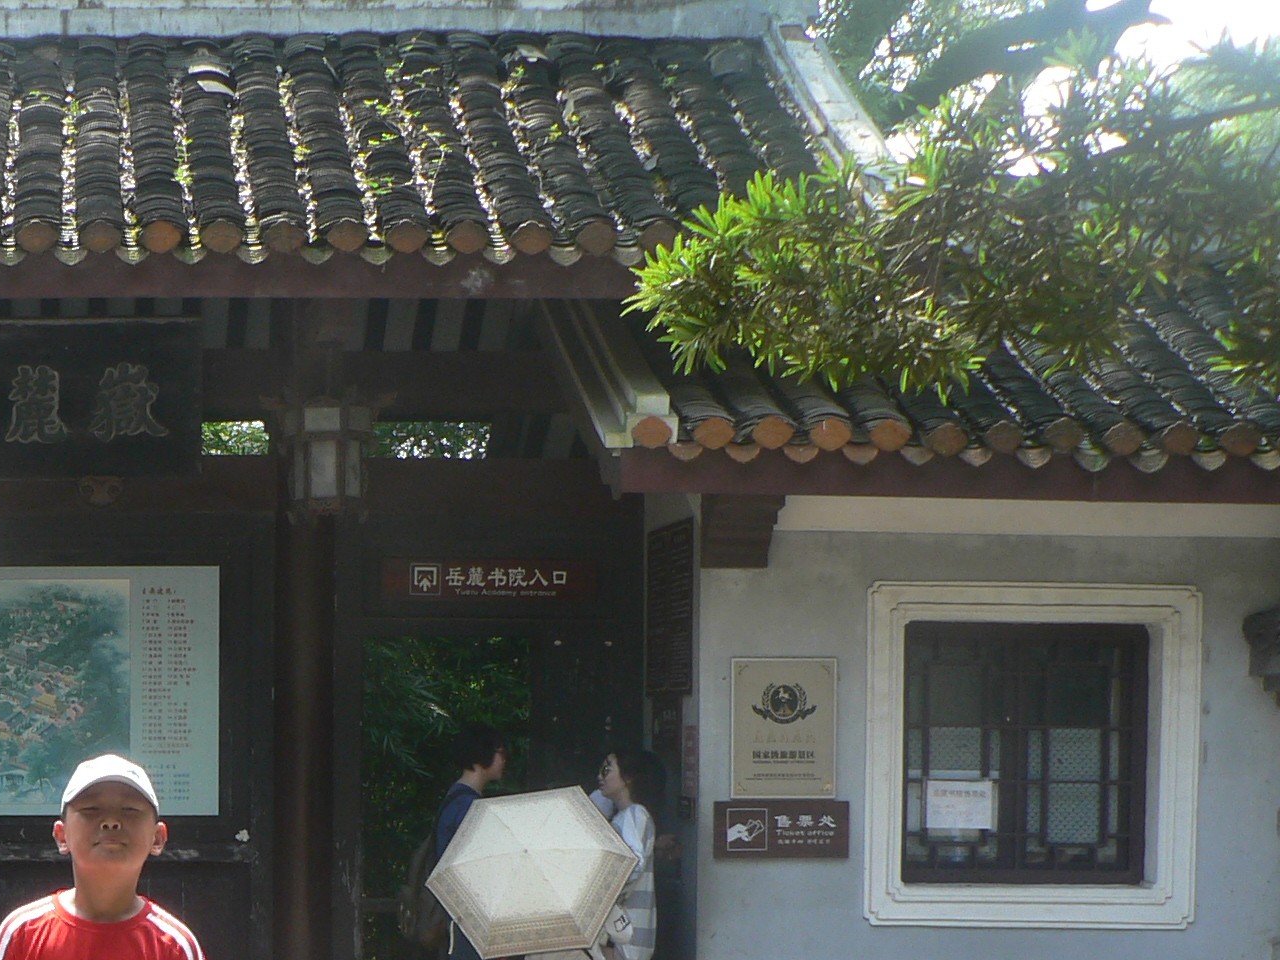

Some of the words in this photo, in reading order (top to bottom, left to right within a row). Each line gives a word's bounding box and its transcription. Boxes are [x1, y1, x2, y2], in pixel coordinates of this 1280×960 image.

[445, 566, 567, 587] 岳麓书院入口
[481, 588, 518, 597] Academy
[773, 814, 837, 828] 售票处
